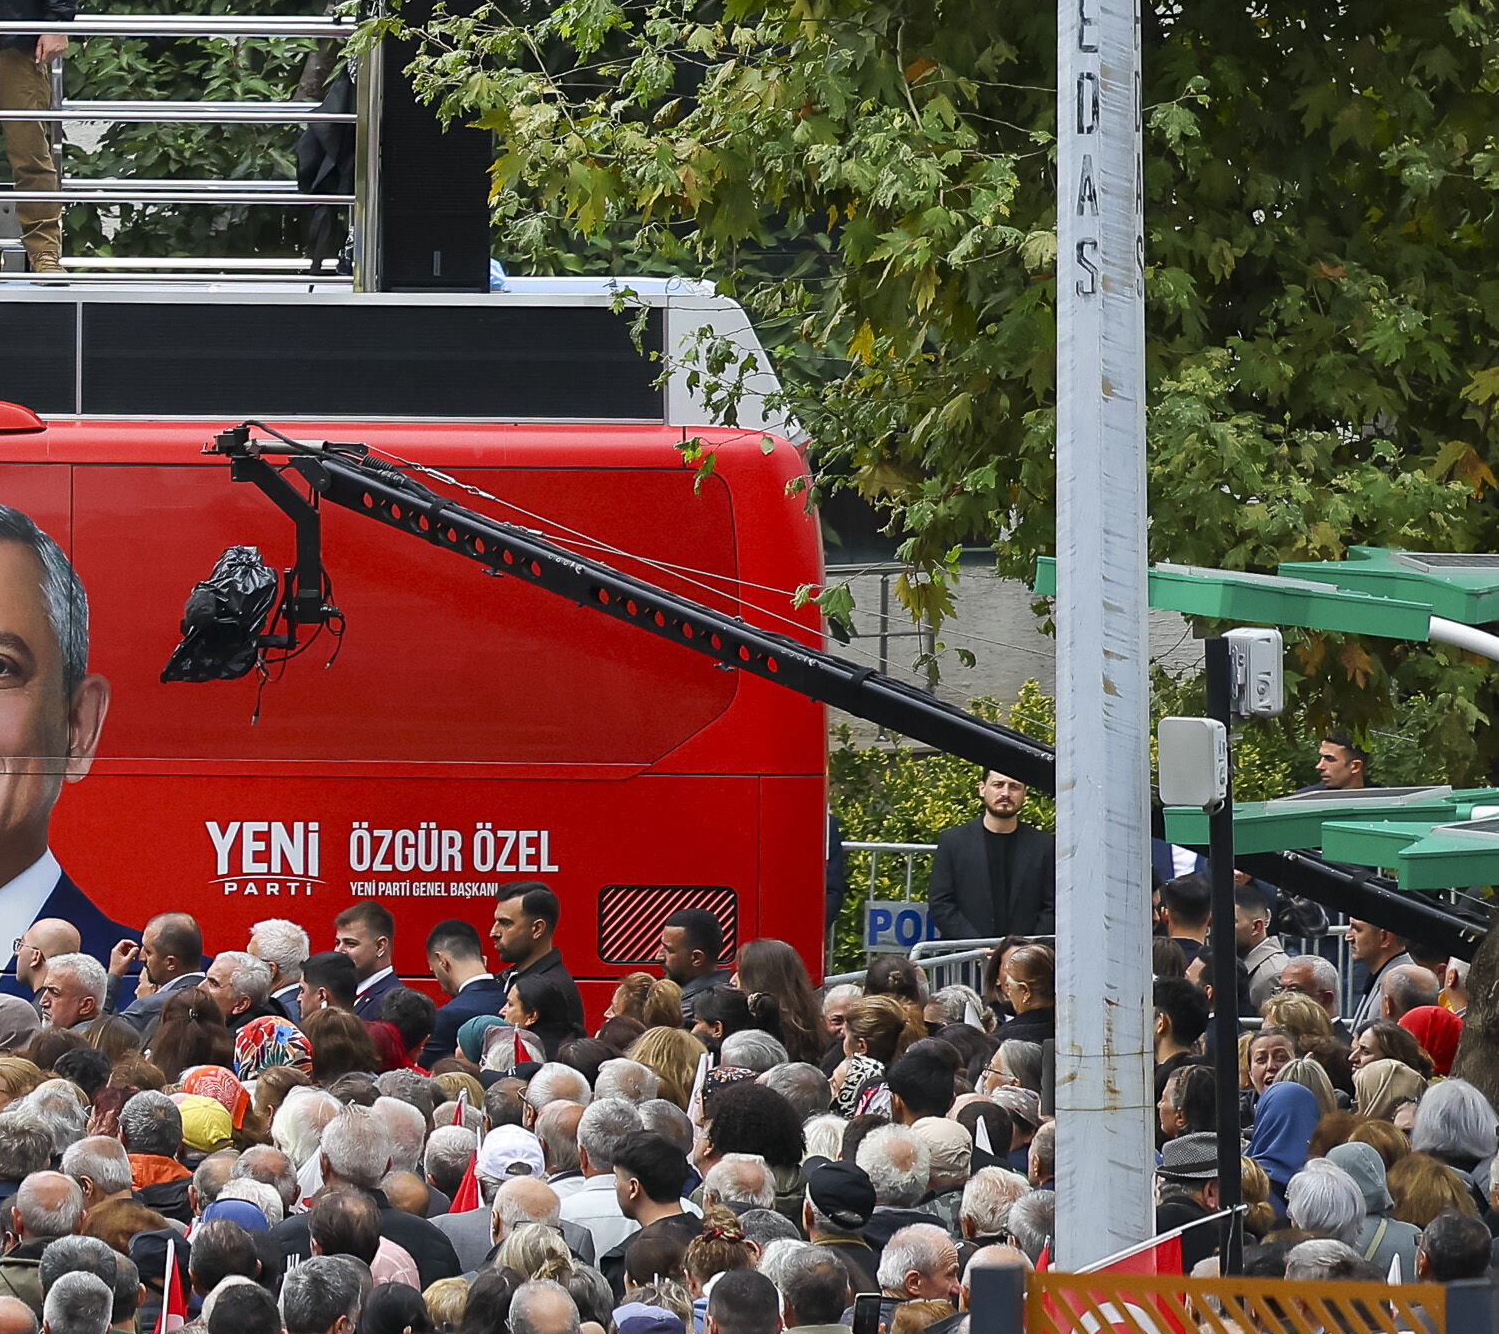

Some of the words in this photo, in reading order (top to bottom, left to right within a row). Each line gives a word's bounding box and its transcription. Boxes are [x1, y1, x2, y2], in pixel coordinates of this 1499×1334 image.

[205, 821, 320, 877] YENİ
[349, 821, 463, 873] ÖZGÜR
[473, 821, 559, 873] ÖZEL
[223, 881, 313, 896] PARTİ
[350, 879, 376, 897] YENİ
[378, 879, 410, 897] PARTİ
[412, 881, 448, 897] GENEL
[869, 909, 939, 946] POL
